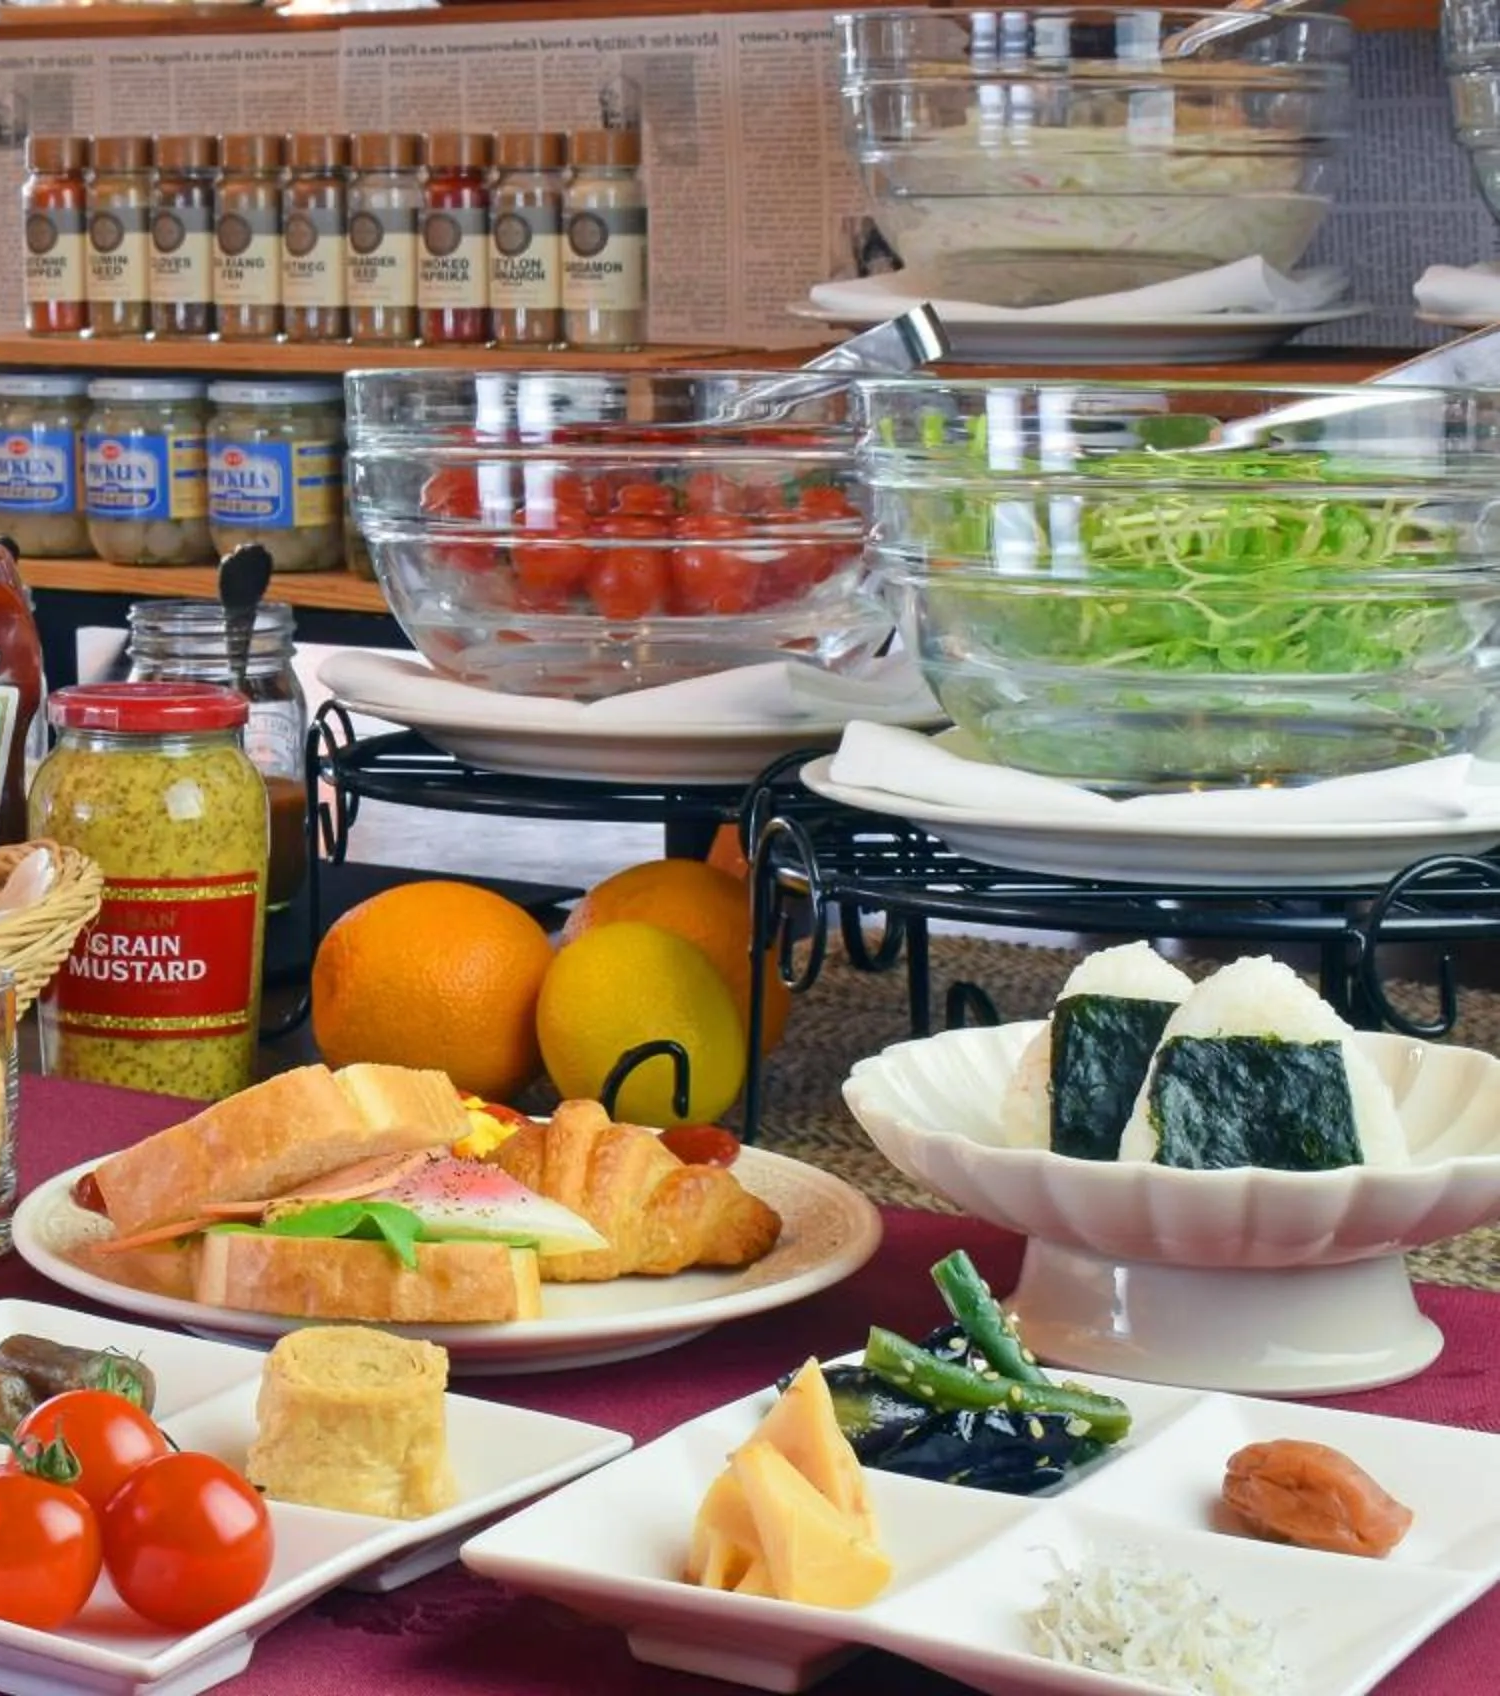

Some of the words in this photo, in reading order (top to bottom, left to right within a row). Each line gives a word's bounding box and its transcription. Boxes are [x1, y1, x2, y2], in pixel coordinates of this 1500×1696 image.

[92, 255, 129, 266] UMIN
[151, 257, 191, 268] LOVES
[421, 257, 469, 270] MOKED
[493, 257, 541, 270] EYLON
[564, 260, 623, 273] ARDAMON
[421, 269, 469, 281] APRIKA
[90, 932, 181, 957] GRAIN
[68, 955, 207, 983] MUSTARD
